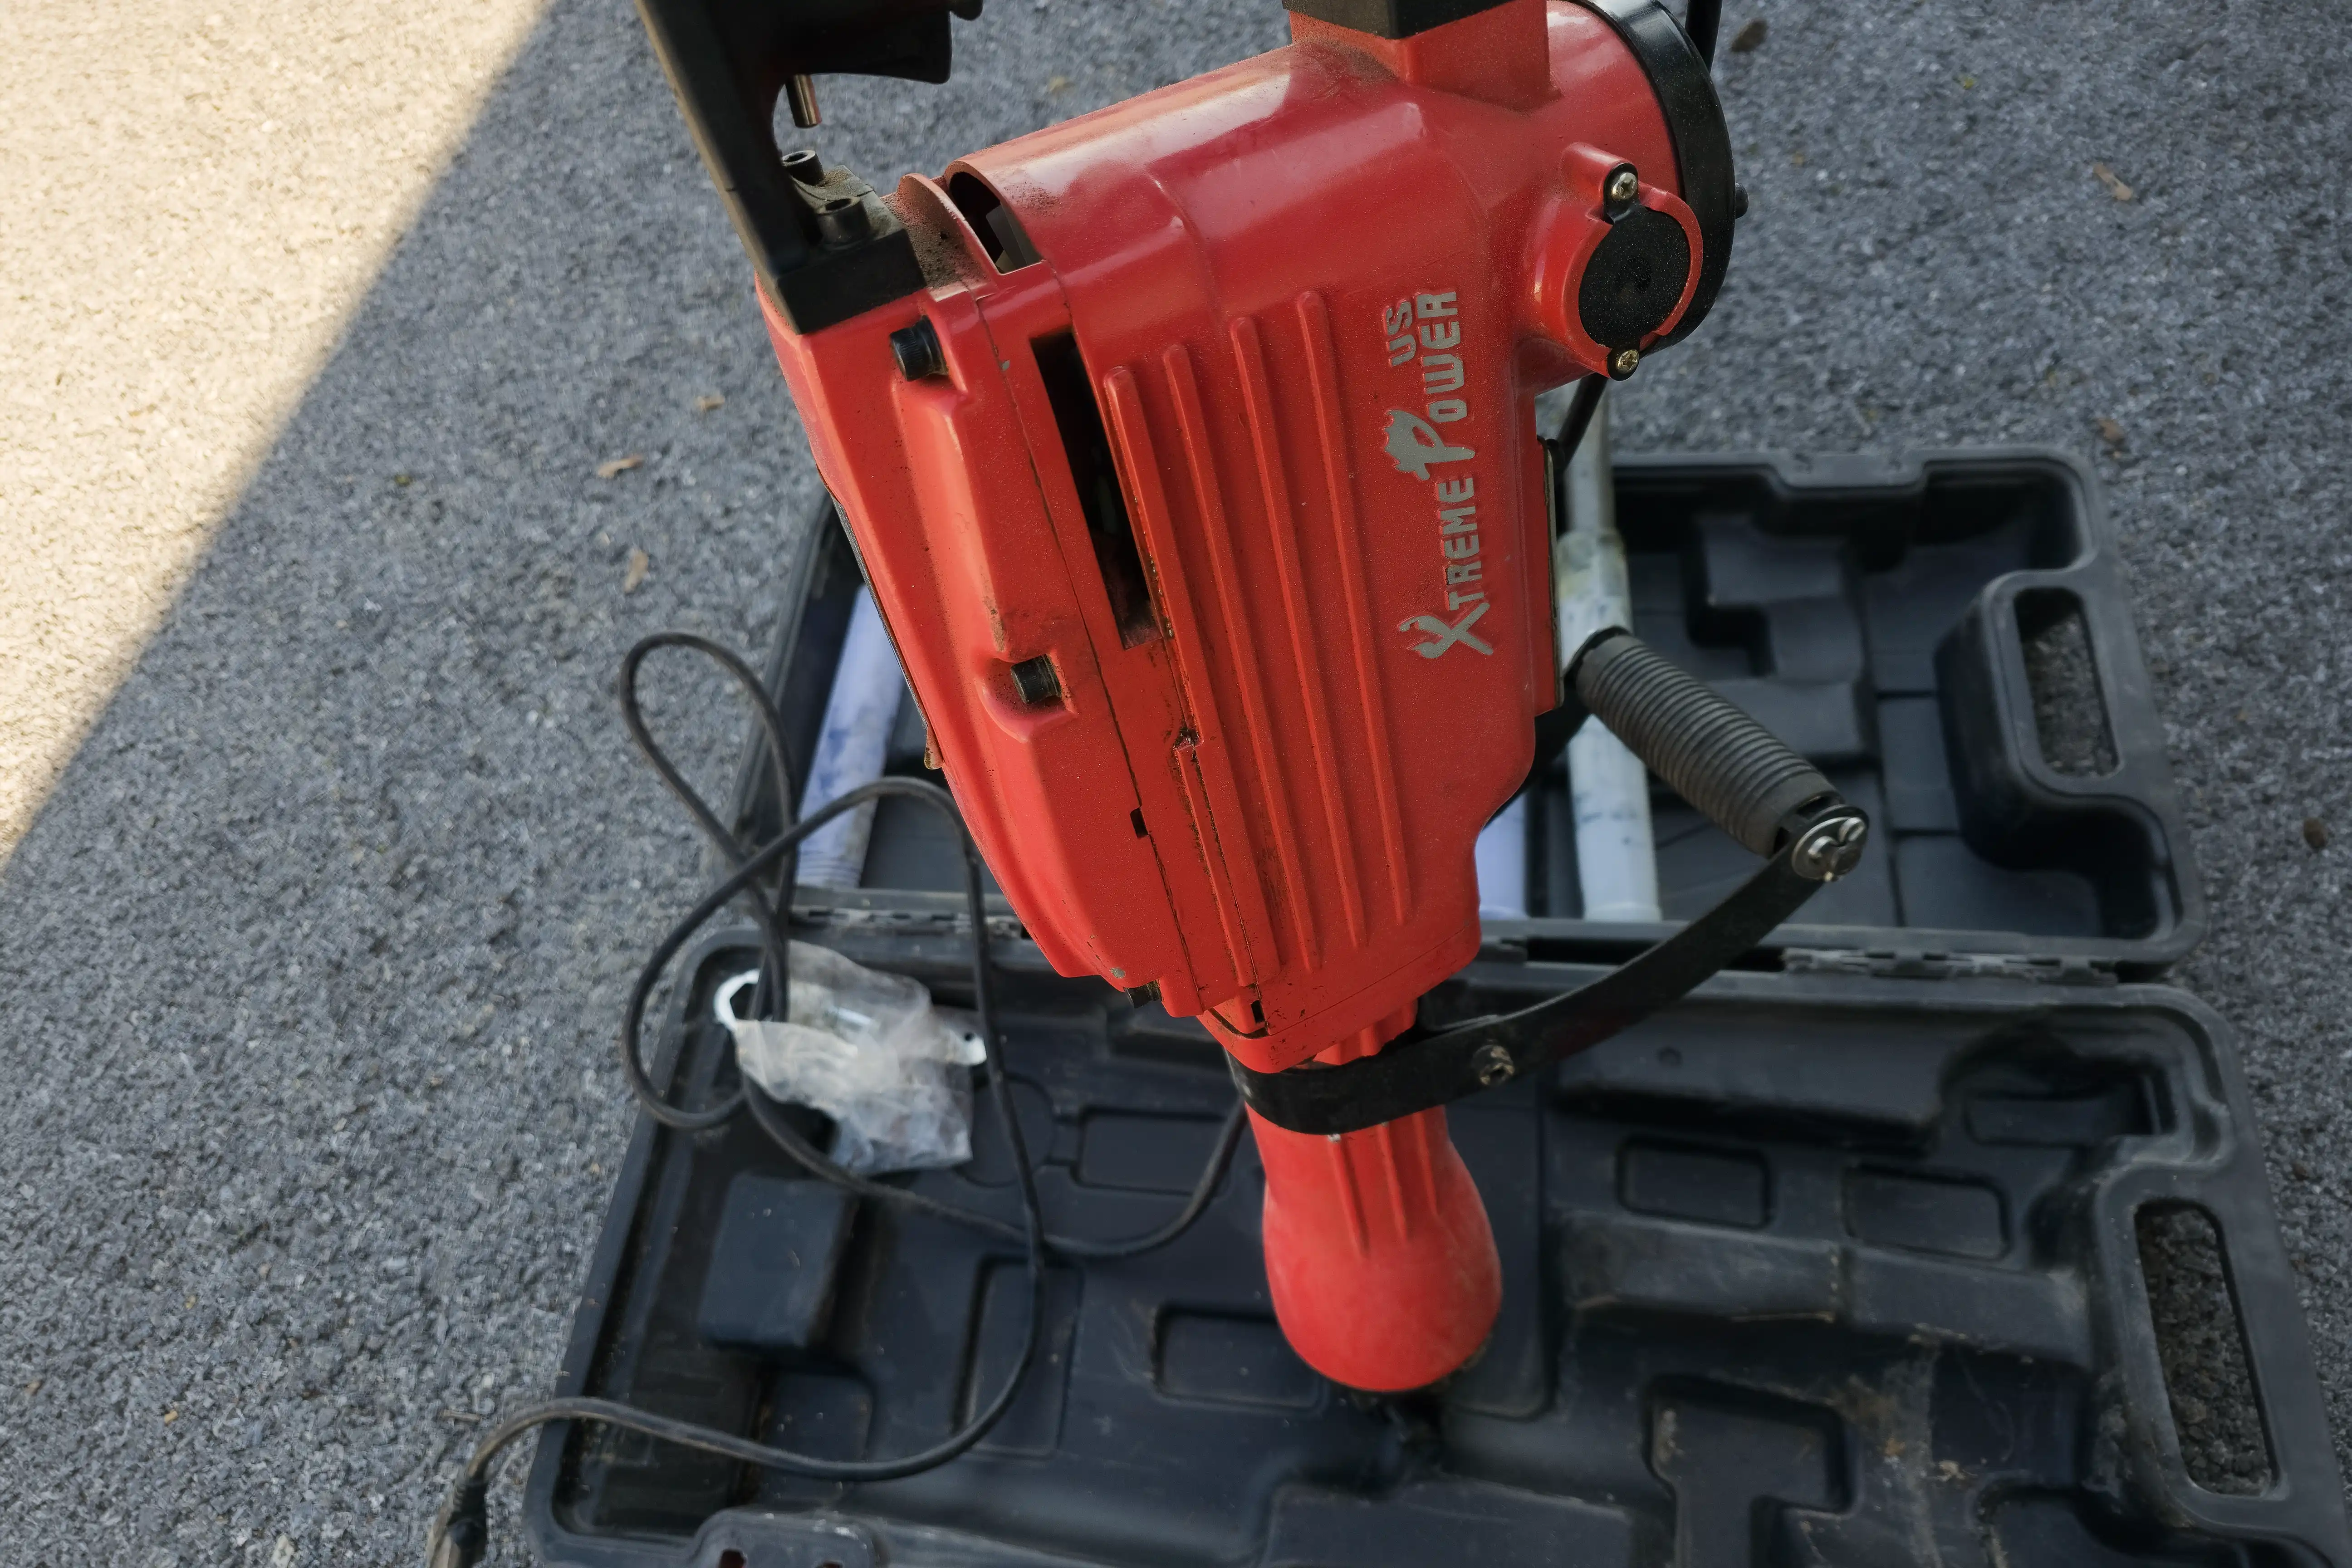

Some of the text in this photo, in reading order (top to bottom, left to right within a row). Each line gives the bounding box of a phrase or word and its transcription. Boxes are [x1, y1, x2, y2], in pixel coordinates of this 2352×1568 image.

[1382, 299, 1416, 367] US
[1383, 290, 1494, 657] XTREME POWER
